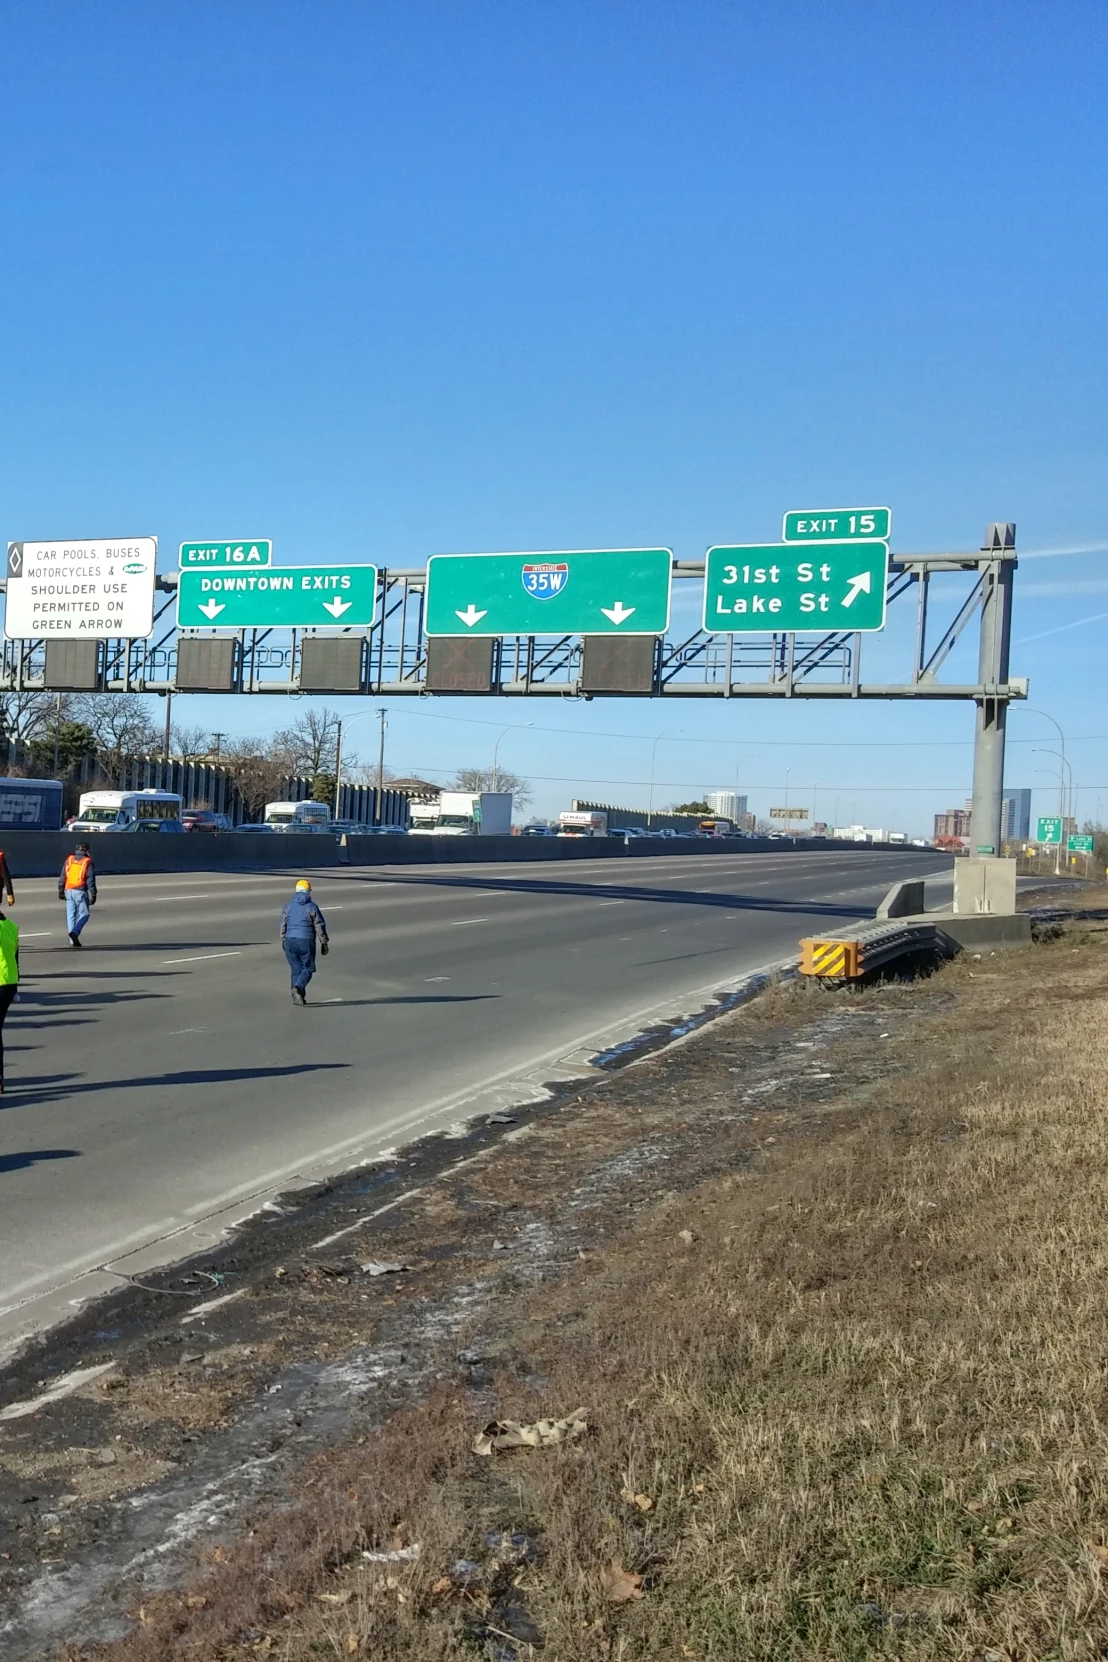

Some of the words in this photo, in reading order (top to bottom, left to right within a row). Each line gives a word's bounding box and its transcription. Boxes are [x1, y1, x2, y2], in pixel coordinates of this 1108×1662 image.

[797, 519, 838, 533] EXIT
[849, 515, 876, 534] 15
[36, 551, 57, 560] CAR
[105, 547, 140, 558] BUSES
[188, 549, 218, 561] EXIT
[224, 545, 261, 562] 16A
[27, 566, 101, 578] MOTORCYCLES
[108, 566, 114, 576] &
[722, 565, 780, 585] 31st
[797, 563, 831, 583] St
[31, 584, 96, 595] SHOULDER
[103, 583, 128, 593] USE
[201, 577, 294, 592] DOWNTOWN
[301, 575, 351, 590] EXITS
[527, 573, 563, 591] 35W
[33, 602, 100, 612] PERMITTED
[107, 601, 124, 611] ON
[716, 594, 782, 614] Lake
[799, 593, 830, 613] St
[32, 620, 72, 630] GREEN
[78, 619, 123, 629] ARROW
